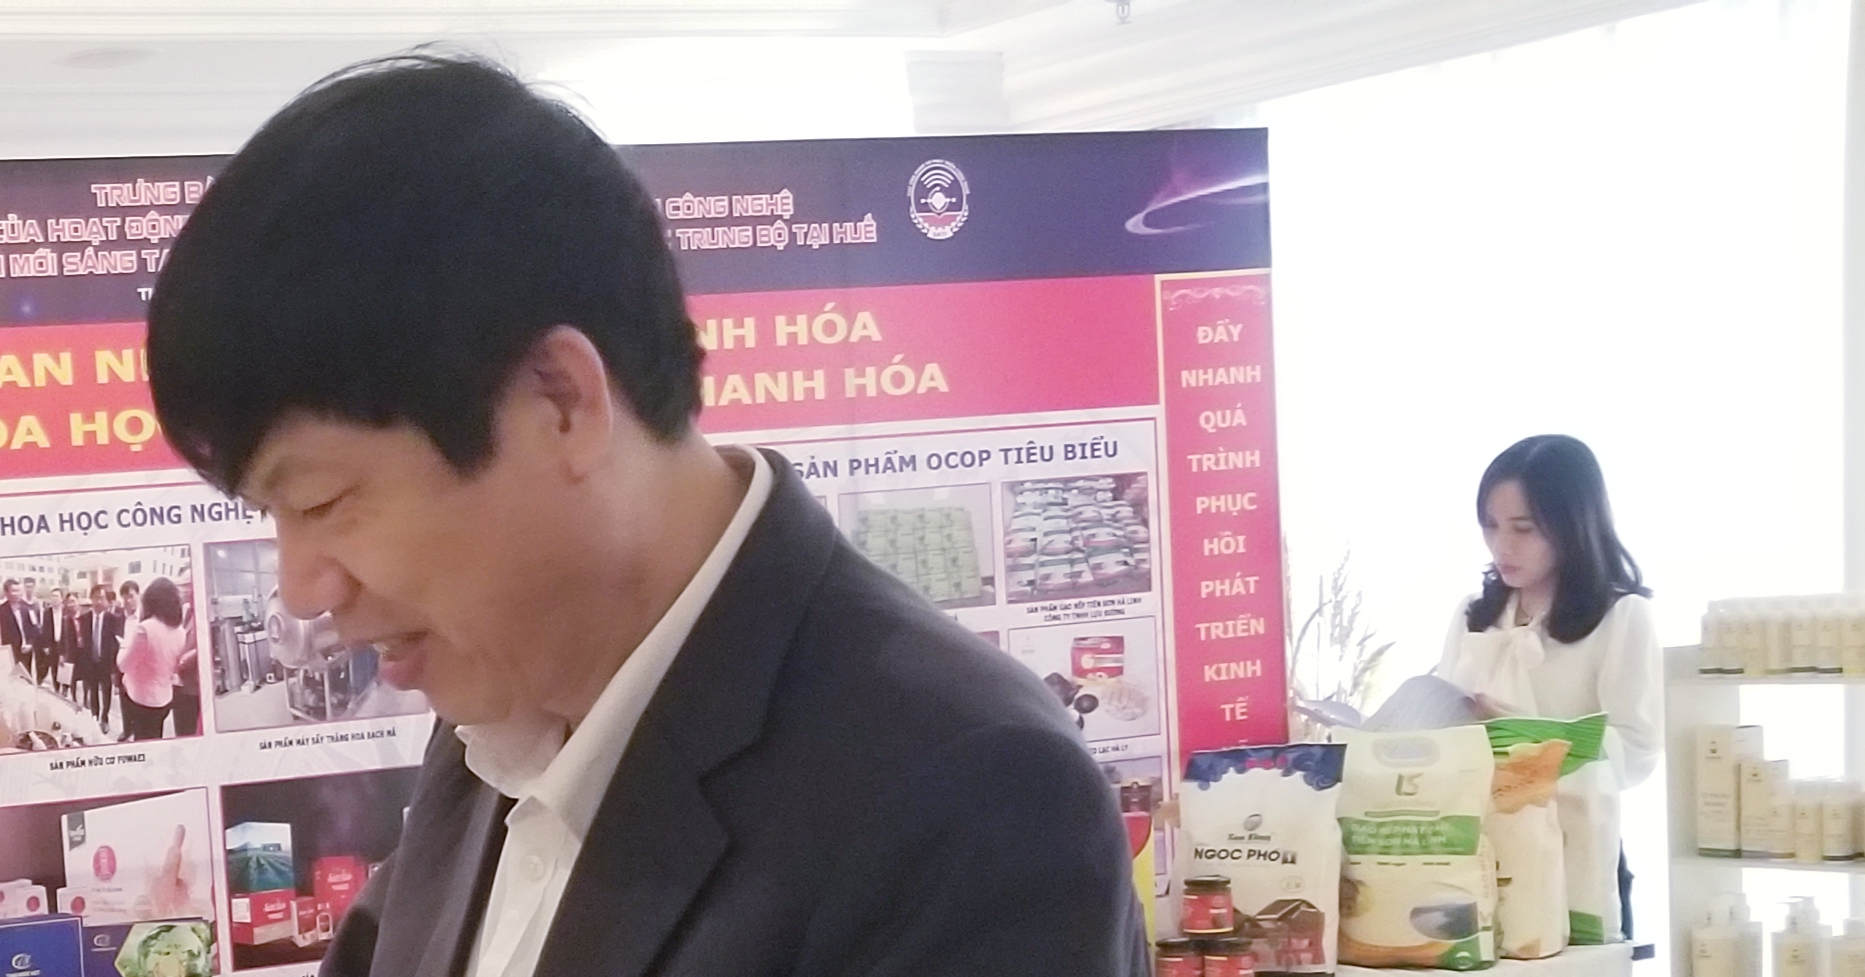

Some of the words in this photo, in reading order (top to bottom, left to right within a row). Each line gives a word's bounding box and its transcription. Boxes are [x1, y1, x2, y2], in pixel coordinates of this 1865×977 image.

[91, 179, 180, 207] TRƯNG
[665, 192, 729, 219] CÔNG
[732, 188, 794, 219] NGHỆ
[47, 217, 121, 245] HOẠT
[125, 210, 190, 244] ĐỘN
[675, 225, 753, 250] TRUNG
[756, 219, 789, 250] BỘ
[792, 223, 829, 249] TẠI
[833, 212, 877, 244] HUẾ
[9, 248, 58, 278] MỚI
[62, 246, 137, 276] SÁNG
[774, 301, 883, 347] HÓA
[1196, 317, 1244, 345] ĐẨY
[844, 353, 950, 399] HÓA
[1180, 364, 1262, 389] NHANH
[69, 409, 164, 452] HỌ
[1199, 403, 1247, 433] QUÁ
[848, 449, 917, 476] PHẨM
[925, 449, 992, 471] OCOP
[999, 441, 1055, 465] TIÊU
[1063, 436, 1118, 462] BIỂU
[1187, 449, 1261, 474] TRÌNH
[58, 509, 109, 537] HỌC
[116, 500, 183, 528] CÔNG
[1195, 491, 1257, 517] PHỤC
[1200, 571, 1260, 599] PHÁT
[1195, 611, 1265, 642] TRIỂN
[1203, 658, 1262, 684] KINH
[1220, 694, 1249, 723] TẾ
